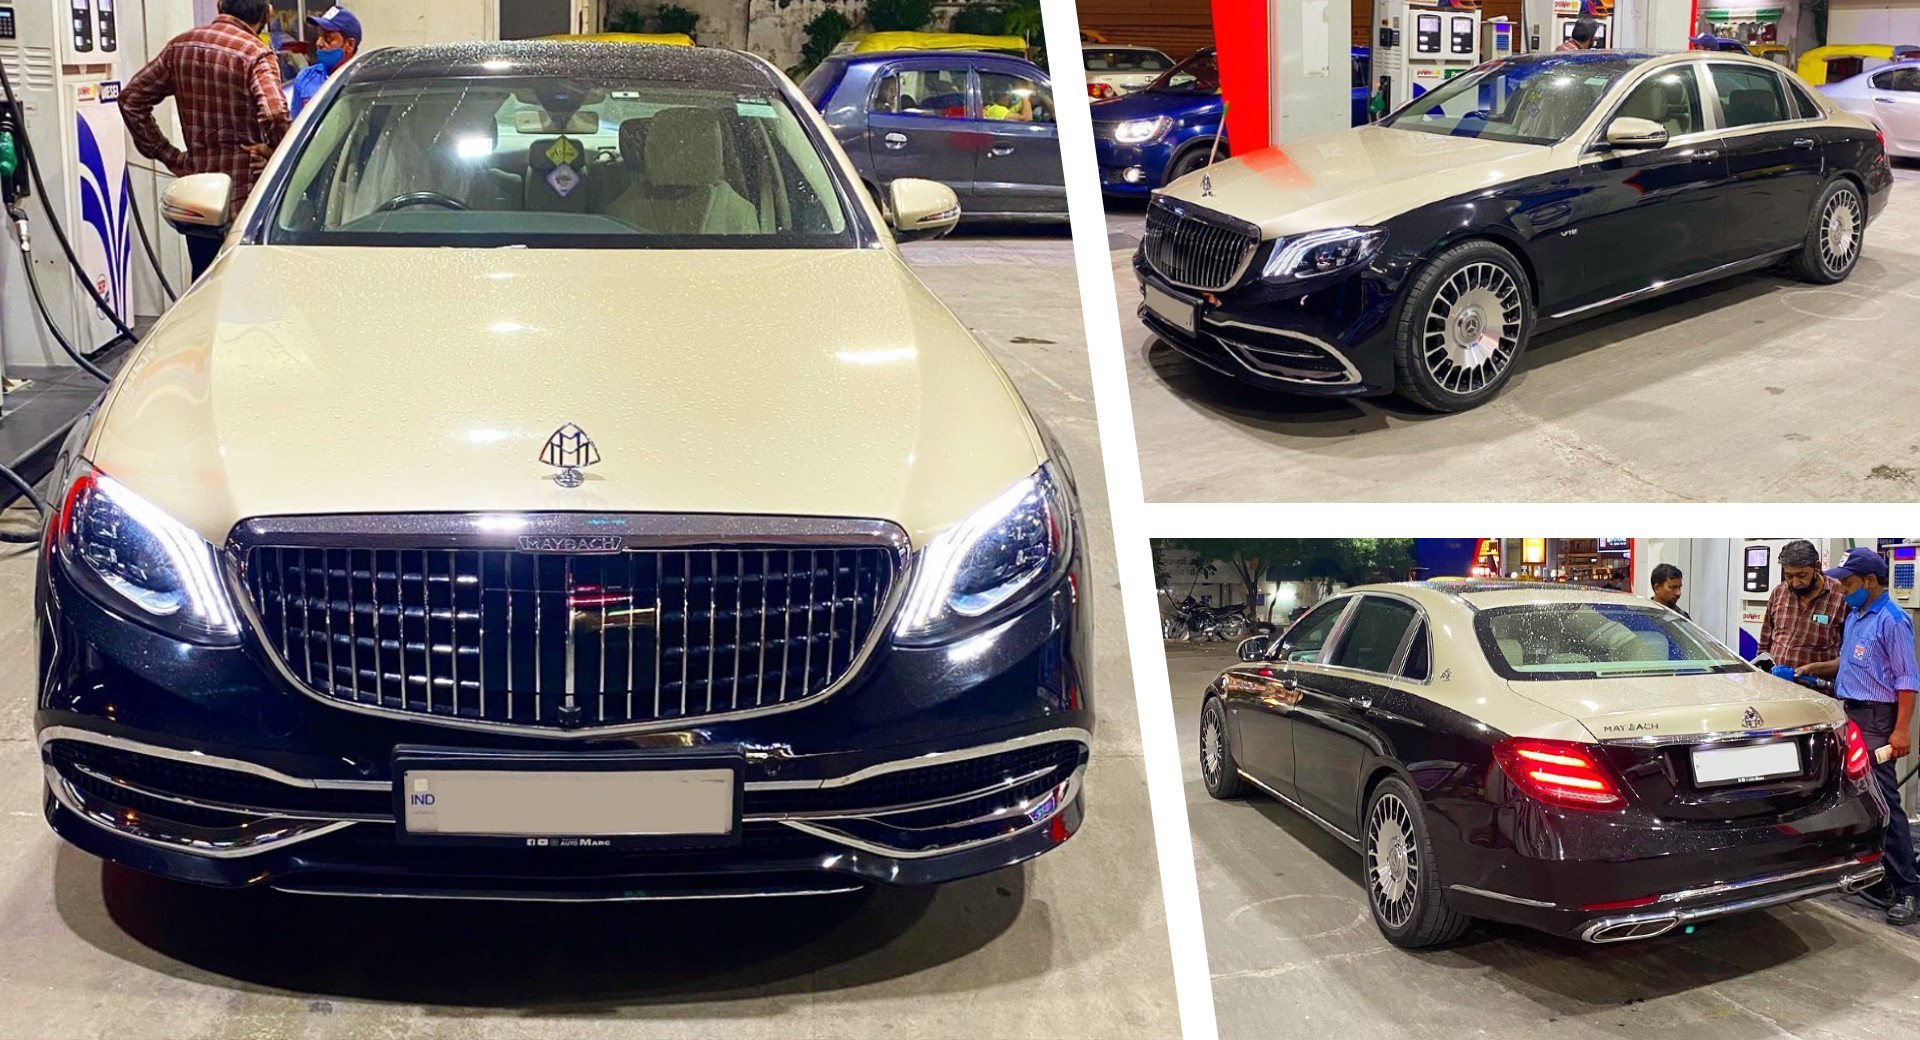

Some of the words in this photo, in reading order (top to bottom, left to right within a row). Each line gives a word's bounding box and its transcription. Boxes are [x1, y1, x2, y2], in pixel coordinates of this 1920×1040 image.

[526, 537, 615, 550] MAYBACH
[1604, 722, 1659, 732] MAYBACH
[411, 793, 435, 805] IND
